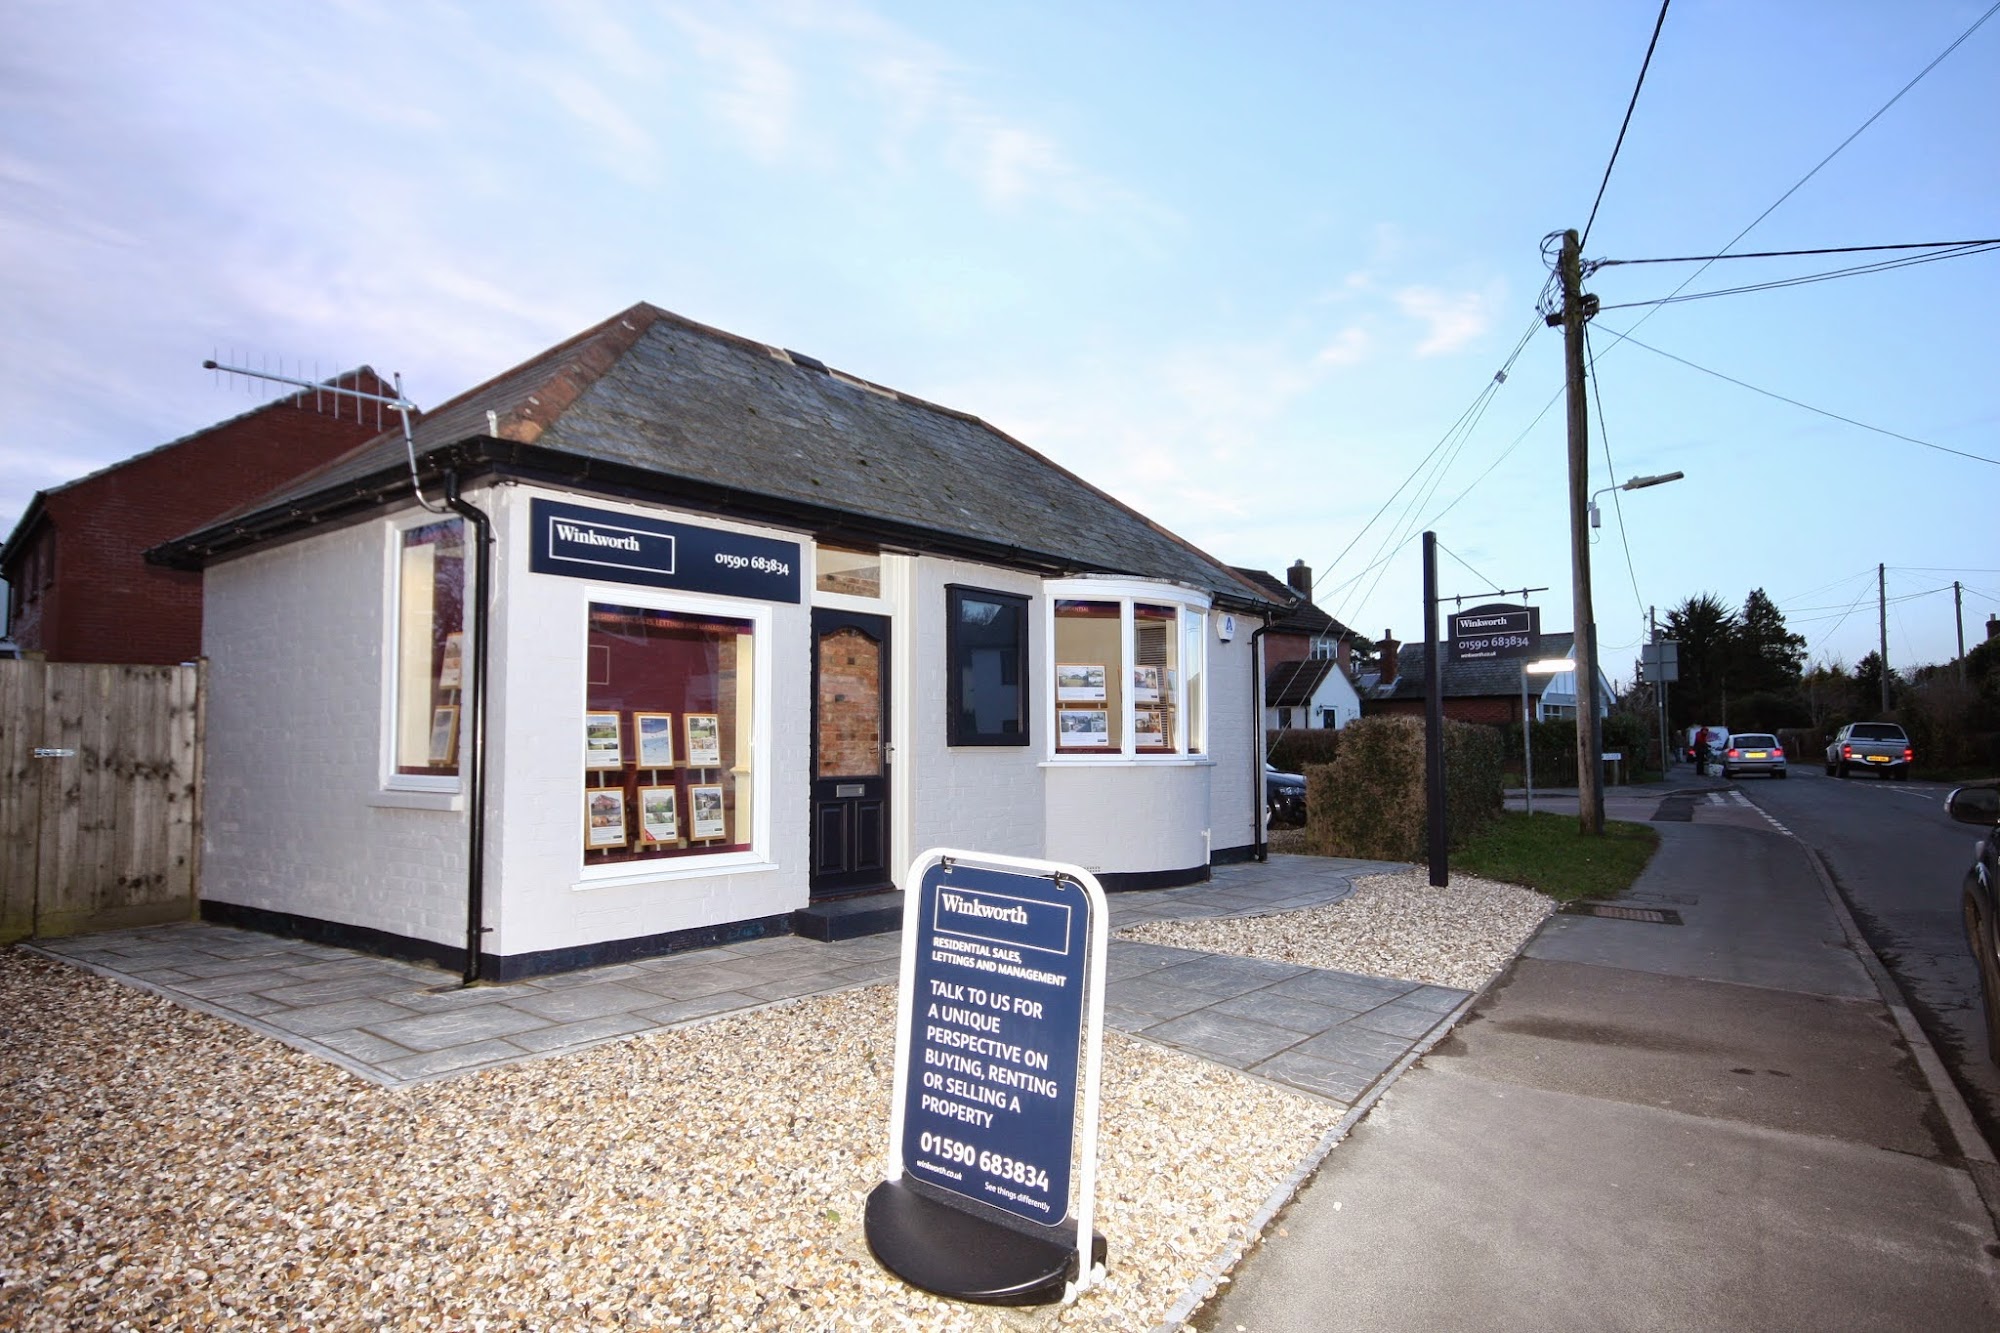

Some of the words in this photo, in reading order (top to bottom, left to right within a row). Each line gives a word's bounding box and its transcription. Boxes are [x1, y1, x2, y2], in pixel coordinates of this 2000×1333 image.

[556, 524, 640, 552] Winkworth
[715, 552, 748, 568] 01590
[751, 556, 789, 576] 683834
[1460, 617, 1507, 628] Winkworth
[1459, 639, 1489, 650] 01590
[1491, 636, 1529, 649] 683834
[942, 893, 1028, 925] Winkworth
[933, 937, 990, 956] RESIDENTIAL
[992, 947, 1022, 964] SALES,
[932, 951, 975, 968] LETTINGS
[976, 959, 997, 972] AND
[998, 963, 1067, 988] MANAGEMENT
[930, 979, 964, 1001] TALK
[967, 987, 986, 1004] TO
[990, 992, 1010, 1012] US
[1014, 997, 1043, 1020] FOR
[928, 1003, 938, 1018] A
[942, 1006, 1000, 1033] UNIQUE
[927, 1025, 1021, 1063] PERSPECTIVE
[1024, 1052, 1048, 1071] ON
[925, 1048, 985, 1080] BUYING,
[988, 1065, 1057, 1098] RENTING
[923, 1072, 943, 1091] OR
[946, 1078, 1006, 1109] SELLING
[1009, 1096, 1021, 1113] A
[922, 1094, 993, 1129] PROPERTY
[916, 1159, 962, 1181] winkworth.co.uk
[920, 1132, 976, 1166] 01590
[979, 1151, 1049, 1193] 683834
[985, 1181, 996, 1192] See
[997, 1185, 1017, 1201] things
[1017, 1192, 1050, 1213] differently
